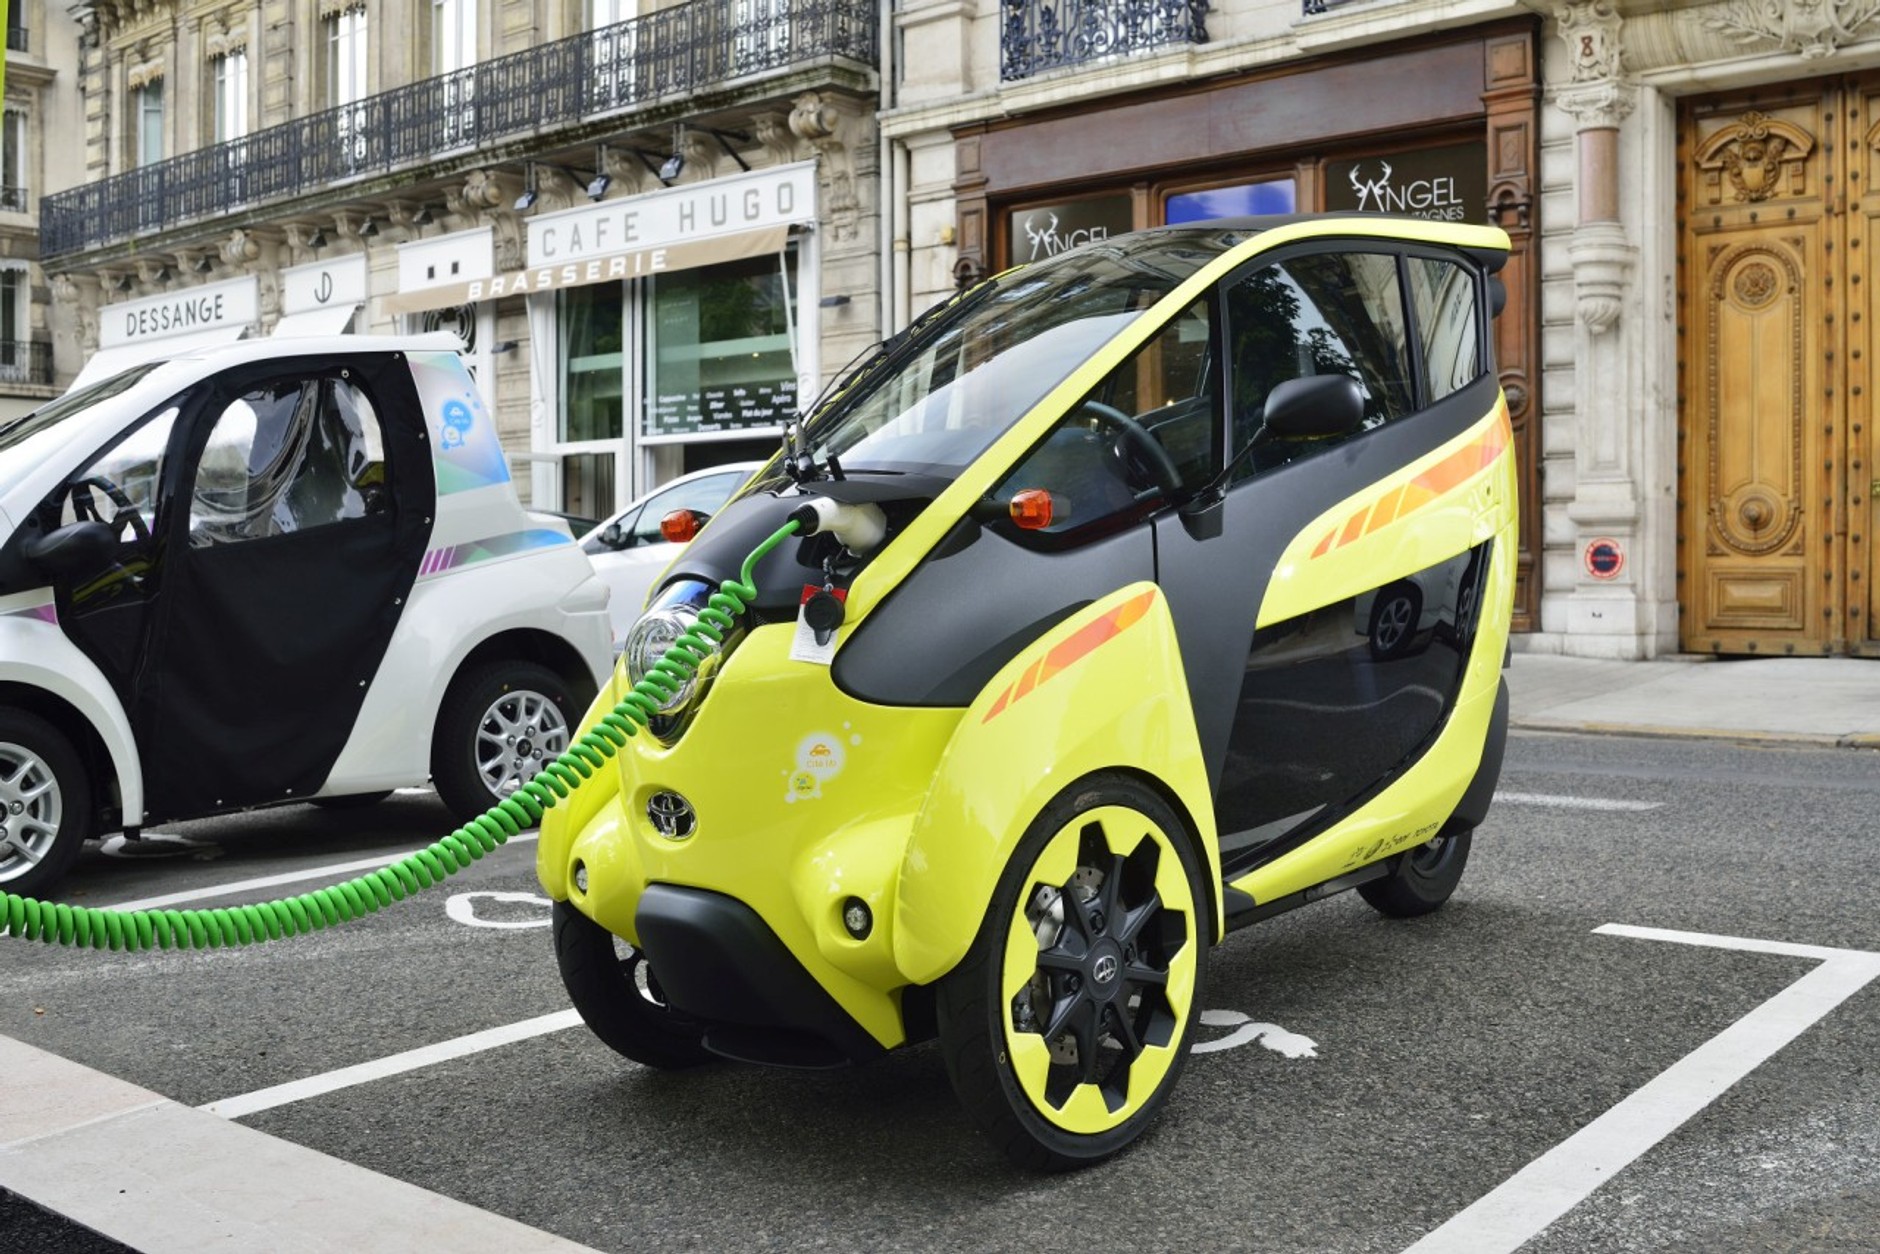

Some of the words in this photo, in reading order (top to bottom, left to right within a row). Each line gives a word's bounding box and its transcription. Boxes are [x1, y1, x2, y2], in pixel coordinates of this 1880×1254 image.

[1581, 35, 1594, 57] 8
[1358, 176, 1463, 212] ANGEL
[542, 211, 640, 257] CAFE
[678, 182, 794, 233] HUGO
[467, 249, 668, 300] BRASSERIE
[126, 294, 224, 337] DESSANGE
